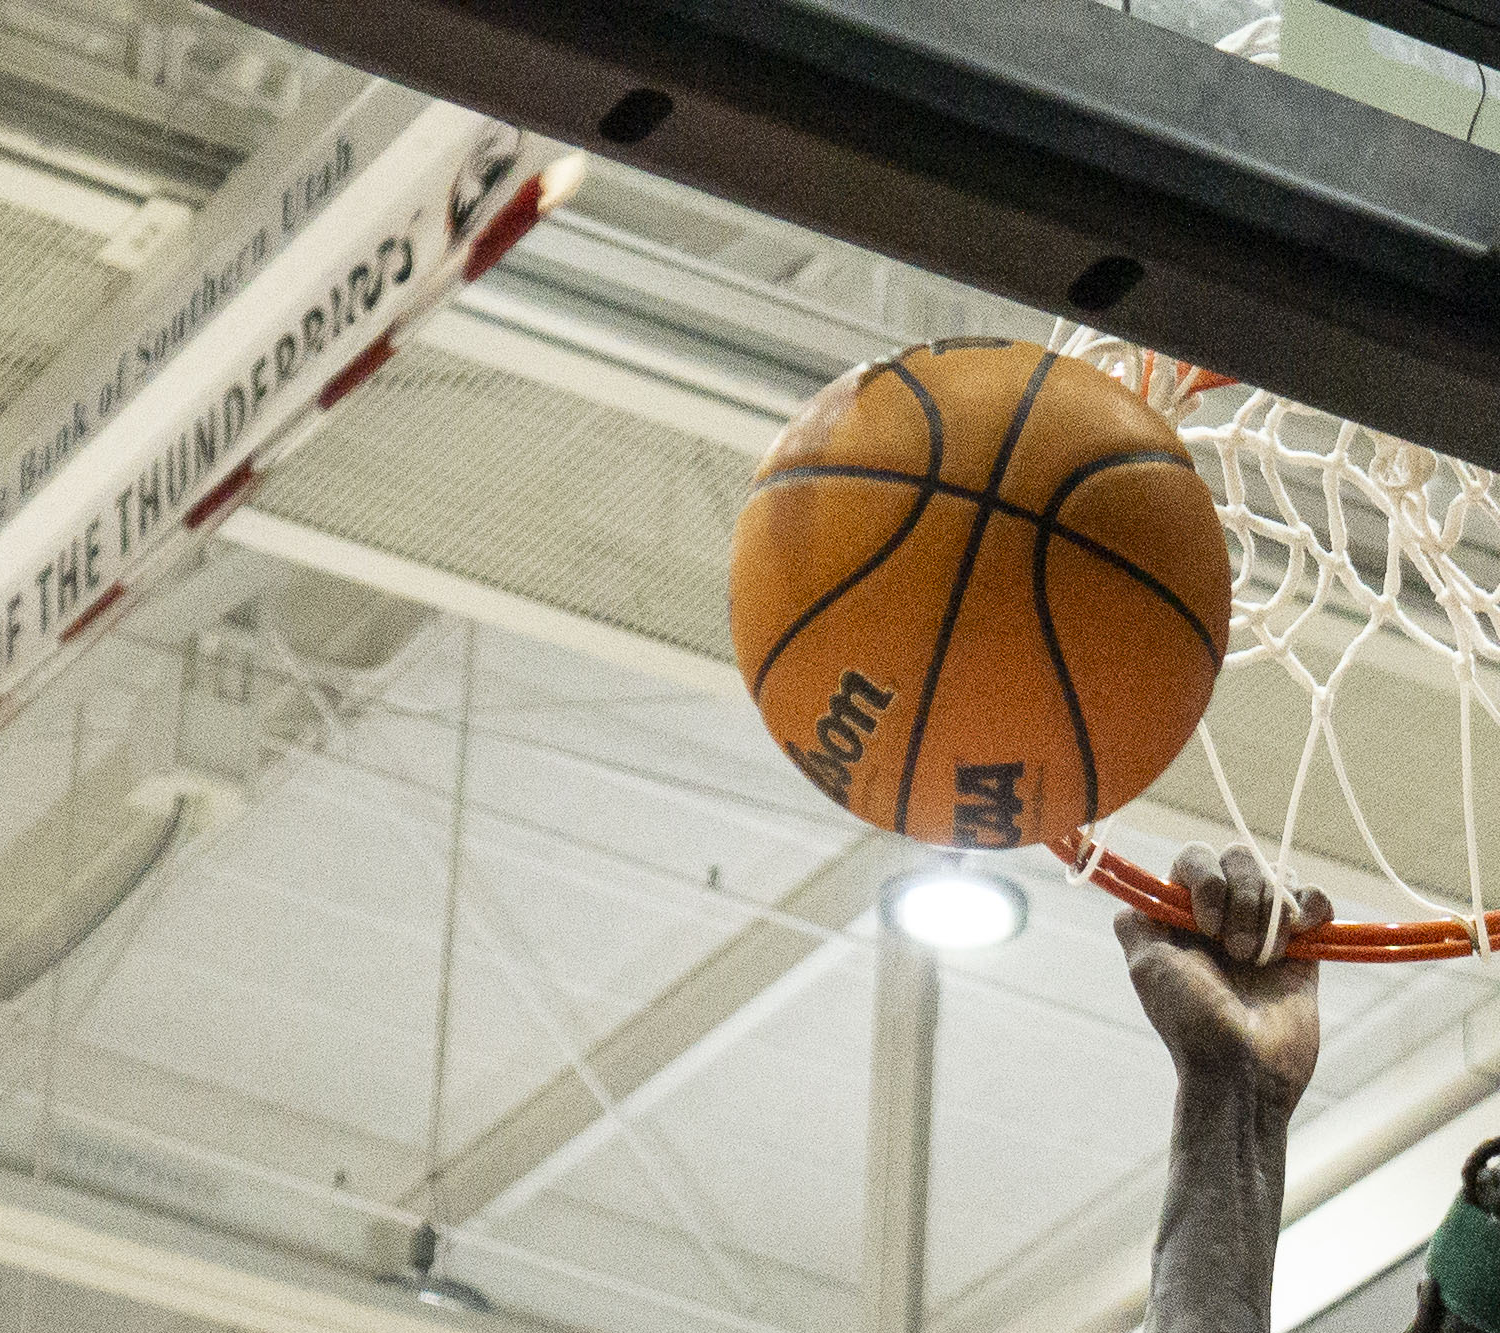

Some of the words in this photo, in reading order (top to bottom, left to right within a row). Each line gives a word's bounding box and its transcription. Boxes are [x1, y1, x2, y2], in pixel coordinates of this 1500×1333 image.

[19, 402, 90, 498] Bank
[98, 350, 129, 418] of
[136, 226, 268, 384] Southern
[282, 135, 352, 236] Utah
[37, 514, 100, 636] THE
